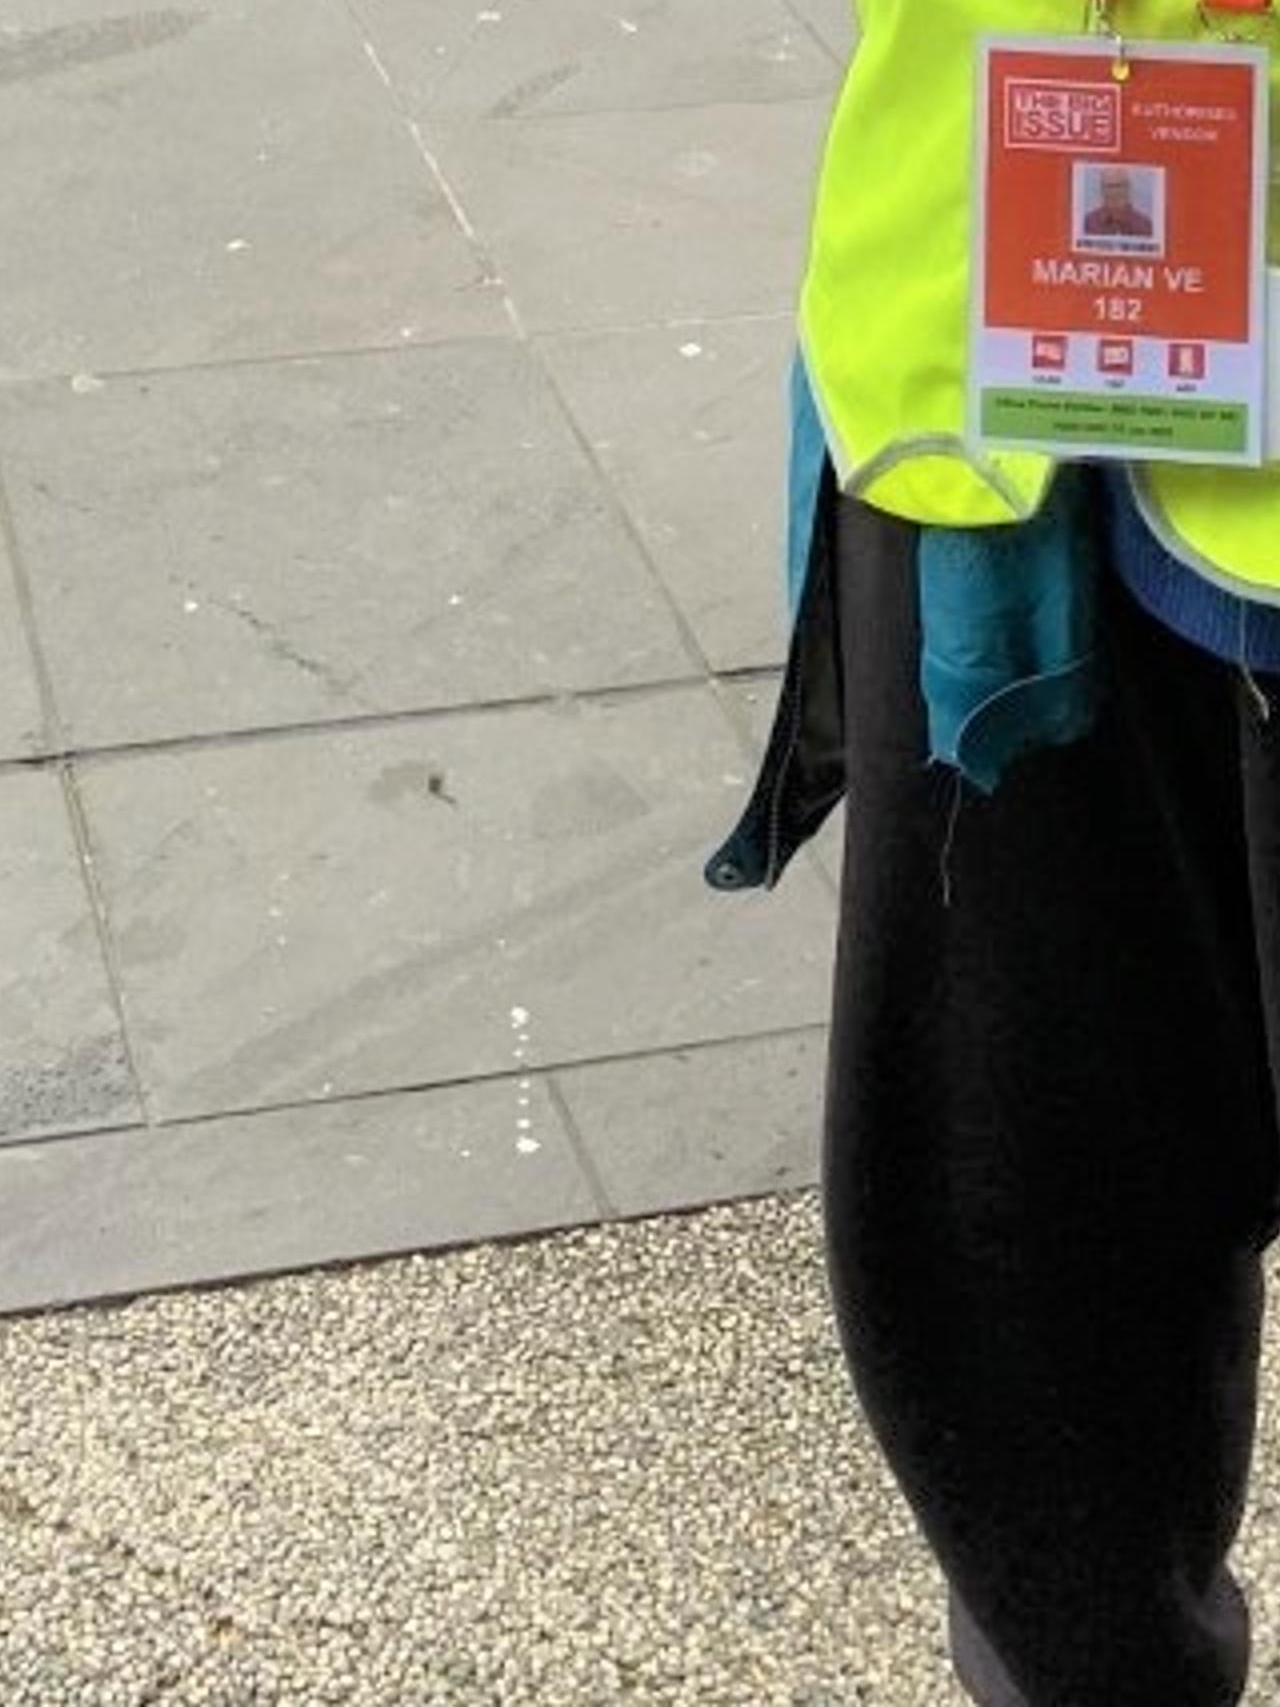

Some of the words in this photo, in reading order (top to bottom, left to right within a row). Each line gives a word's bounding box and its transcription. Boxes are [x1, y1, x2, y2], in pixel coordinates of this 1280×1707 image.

[1012, 109, 1114, 144] ISSUE
[1031, 258, 1154, 289] MARIAN
[1164, 265, 1205, 293] VE
[1094, 298, 1142, 322] 182
